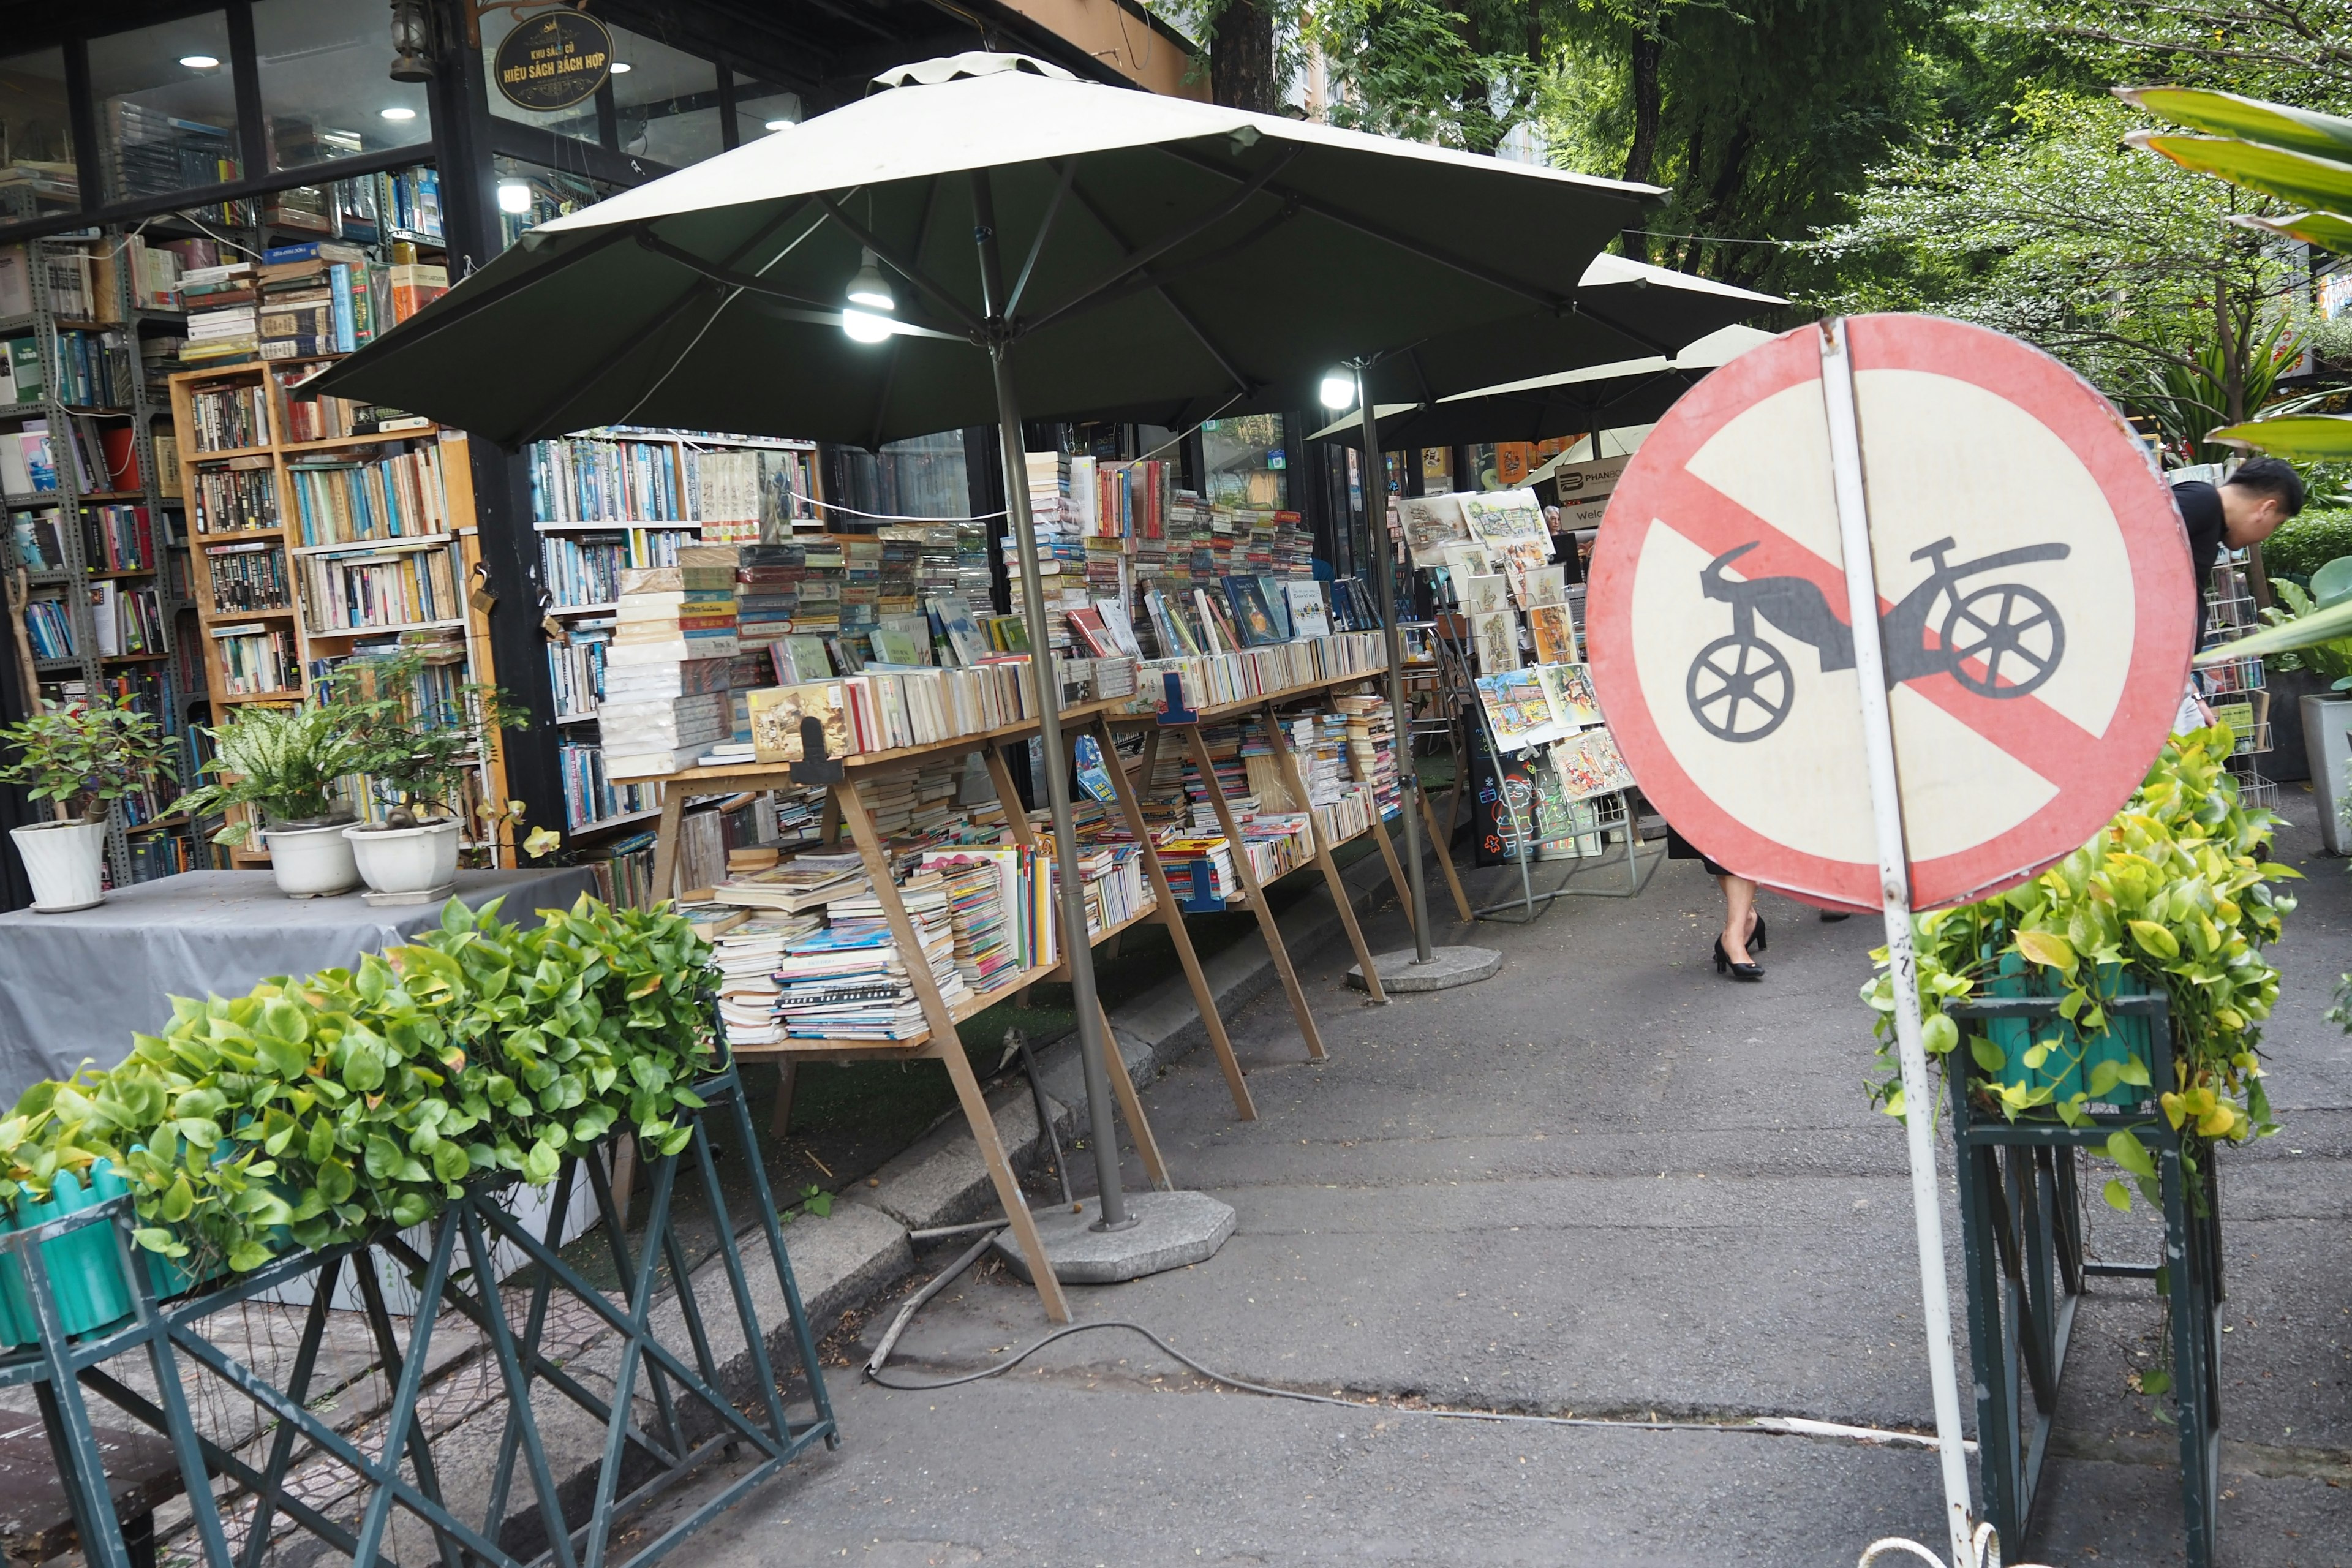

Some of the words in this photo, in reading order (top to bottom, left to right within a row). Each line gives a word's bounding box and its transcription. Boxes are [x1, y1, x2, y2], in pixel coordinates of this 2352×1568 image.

[531, 50, 546, 60] KHU
[546, 45, 564, 56] SÁCH
[565, 41, 575, 53] CŨ
[503, 66, 526, 84] HIỆU
[529, 60, 554, 78] SÁCH
[557, 55, 584, 74] BÁCH
[585, 52, 605, 70] HỢP
[1585, 470, 1623, 481] PHANBO
[1577, 510, 1602, 520] Welc
[595, 657, 604, 689] FELLSIDE
